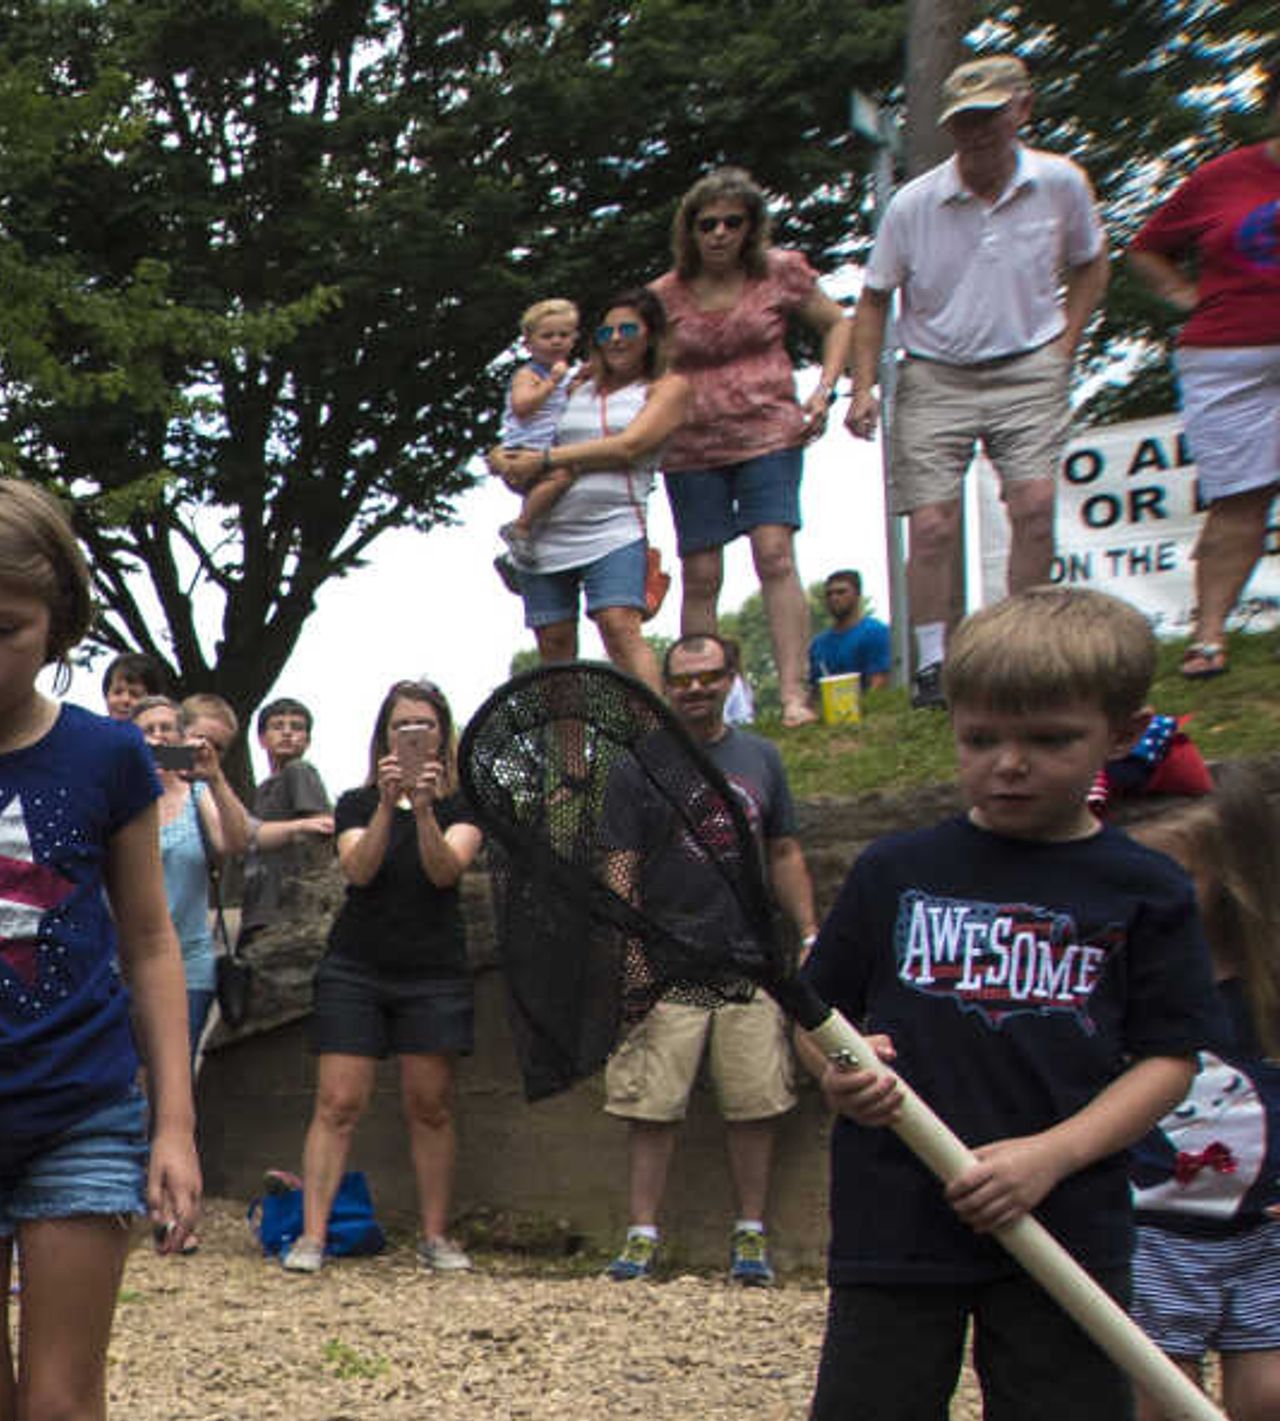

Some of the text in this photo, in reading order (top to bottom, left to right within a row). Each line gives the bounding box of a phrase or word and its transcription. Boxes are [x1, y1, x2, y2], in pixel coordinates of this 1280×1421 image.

[1063, 432, 1196, 484] O AL
[1080, 485, 1167, 530] OR
[1105, 541, 1177, 578] THE
[898, 901, 1105, 1000] AWESOME
